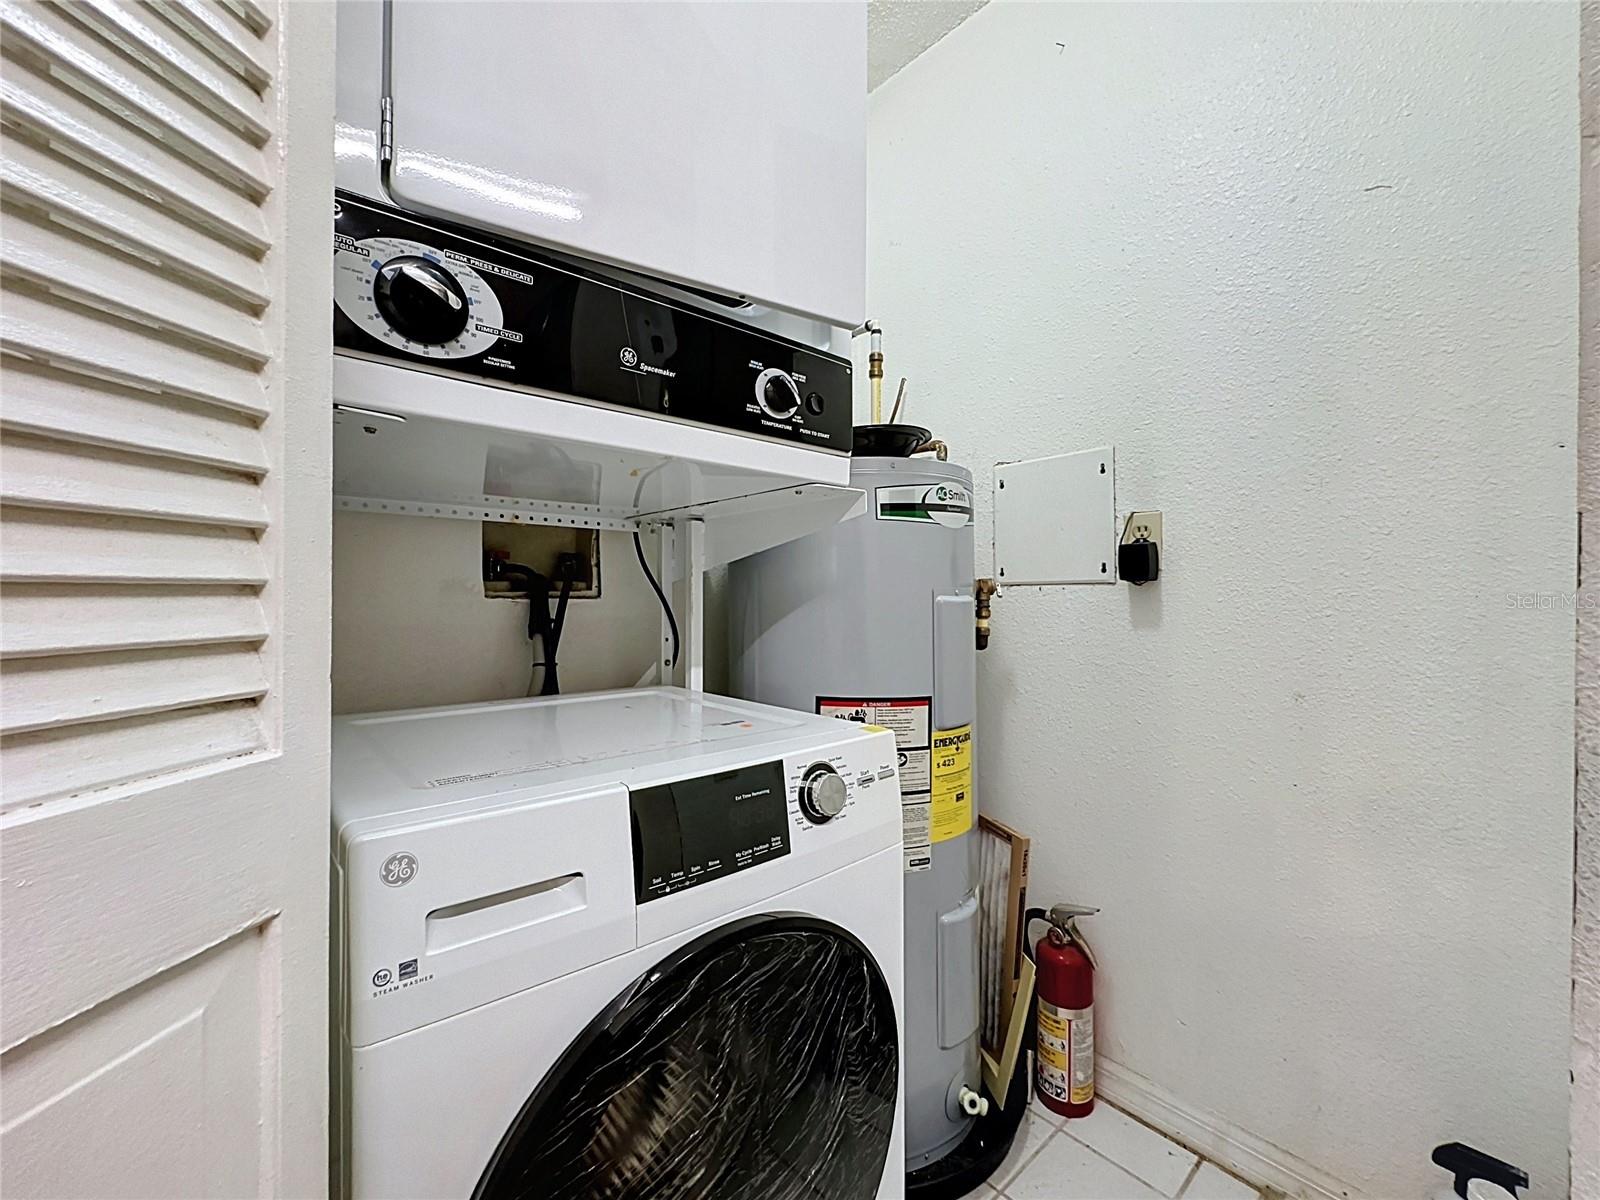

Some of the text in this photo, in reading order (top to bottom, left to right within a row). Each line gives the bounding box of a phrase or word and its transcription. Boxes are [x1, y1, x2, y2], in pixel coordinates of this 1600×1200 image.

[334, 242, 370, 257] EGULAR
[446, 251, 469, 264] PERM.
[470, 258, 493, 272] PRESS
[500, 268, 531, 284] DELICATE
[476, 325, 521, 341] TIMED CYCLE
[640, 362, 676, 378] Spacemaker
[761, 420, 793, 431] TEMPERATURE
[799, 428, 811, 436] PUSH
[942, 758, 956, 768] 423
[652, 877, 662, 885] Soil
[670, 871, 684, 879] Temp
[372, 974, 434, 998] STEAM WASHER
